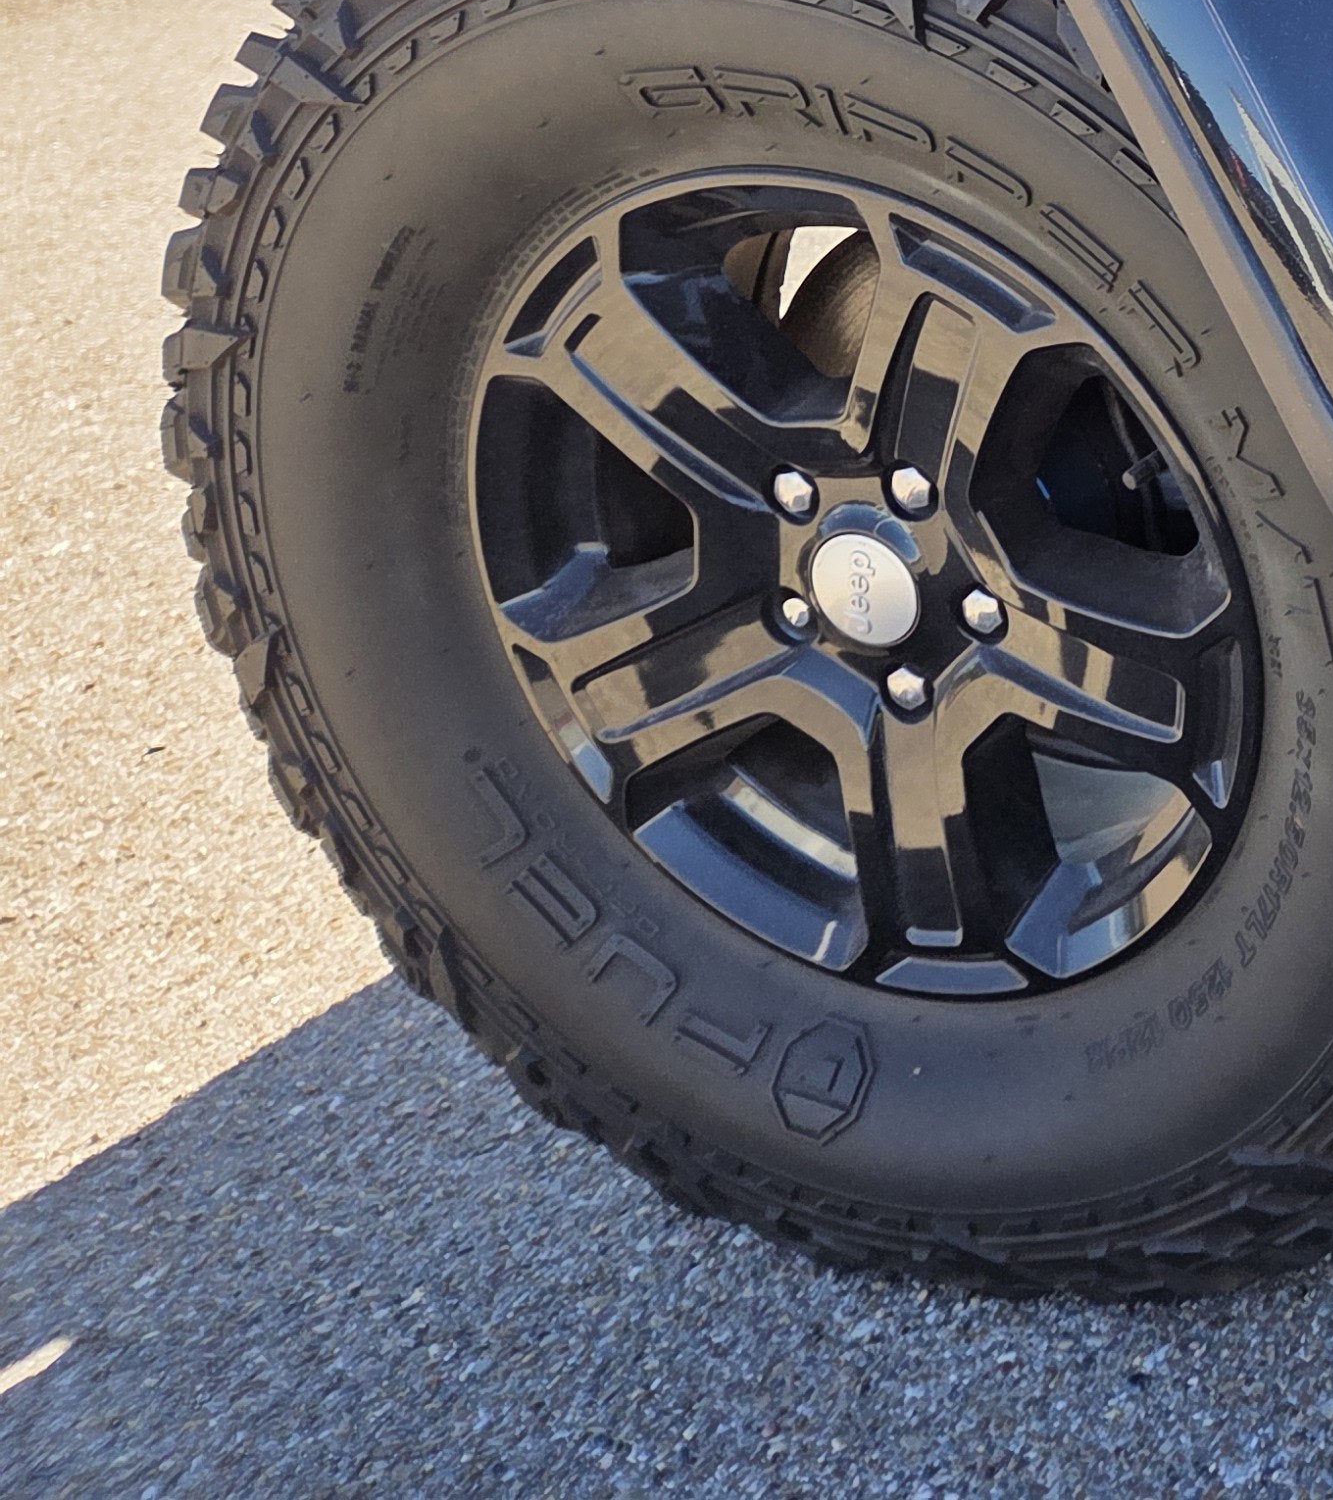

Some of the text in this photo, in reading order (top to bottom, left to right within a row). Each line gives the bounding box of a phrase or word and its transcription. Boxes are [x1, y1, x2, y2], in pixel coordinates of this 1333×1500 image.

[619, 65, 1202, 378] GRIPPER
[843, 549, 877, 635] Jeep
[475, 764, 773, 1079] FUEL
